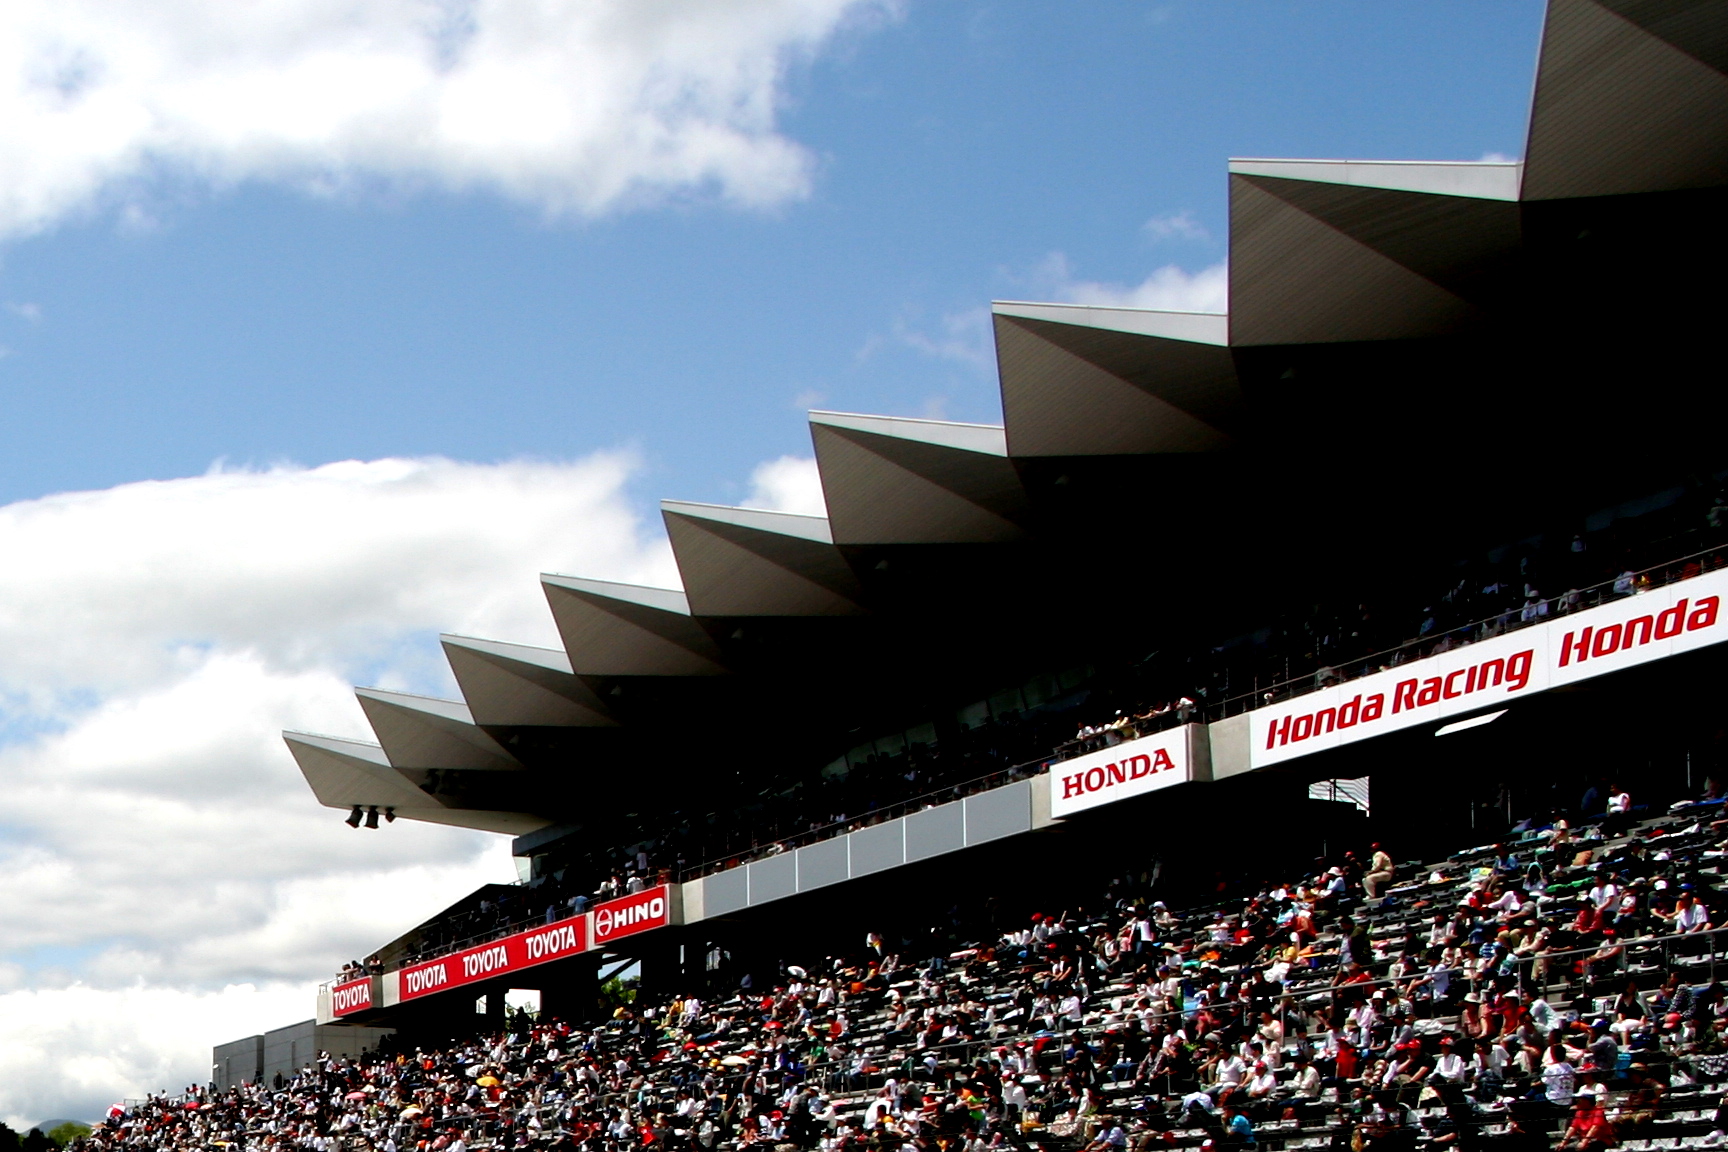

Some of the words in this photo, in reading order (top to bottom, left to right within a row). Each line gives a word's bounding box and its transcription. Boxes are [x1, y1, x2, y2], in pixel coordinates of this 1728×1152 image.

[1265, 692, 1385, 751] Honda
[1391, 648, 1534, 715] Racing
[1558, 595, 1720, 668] Honda
[1062, 748, 1175, 800] HONDA
[614, 897, 663, 929] HINO
[406, 963, 447, 993] TOYOTA
[463, 946, 508, 977] TOYOTA
[526, 925, 576, 959] TOYOTA
[334, 983, 370, 1011] TOYOTA
